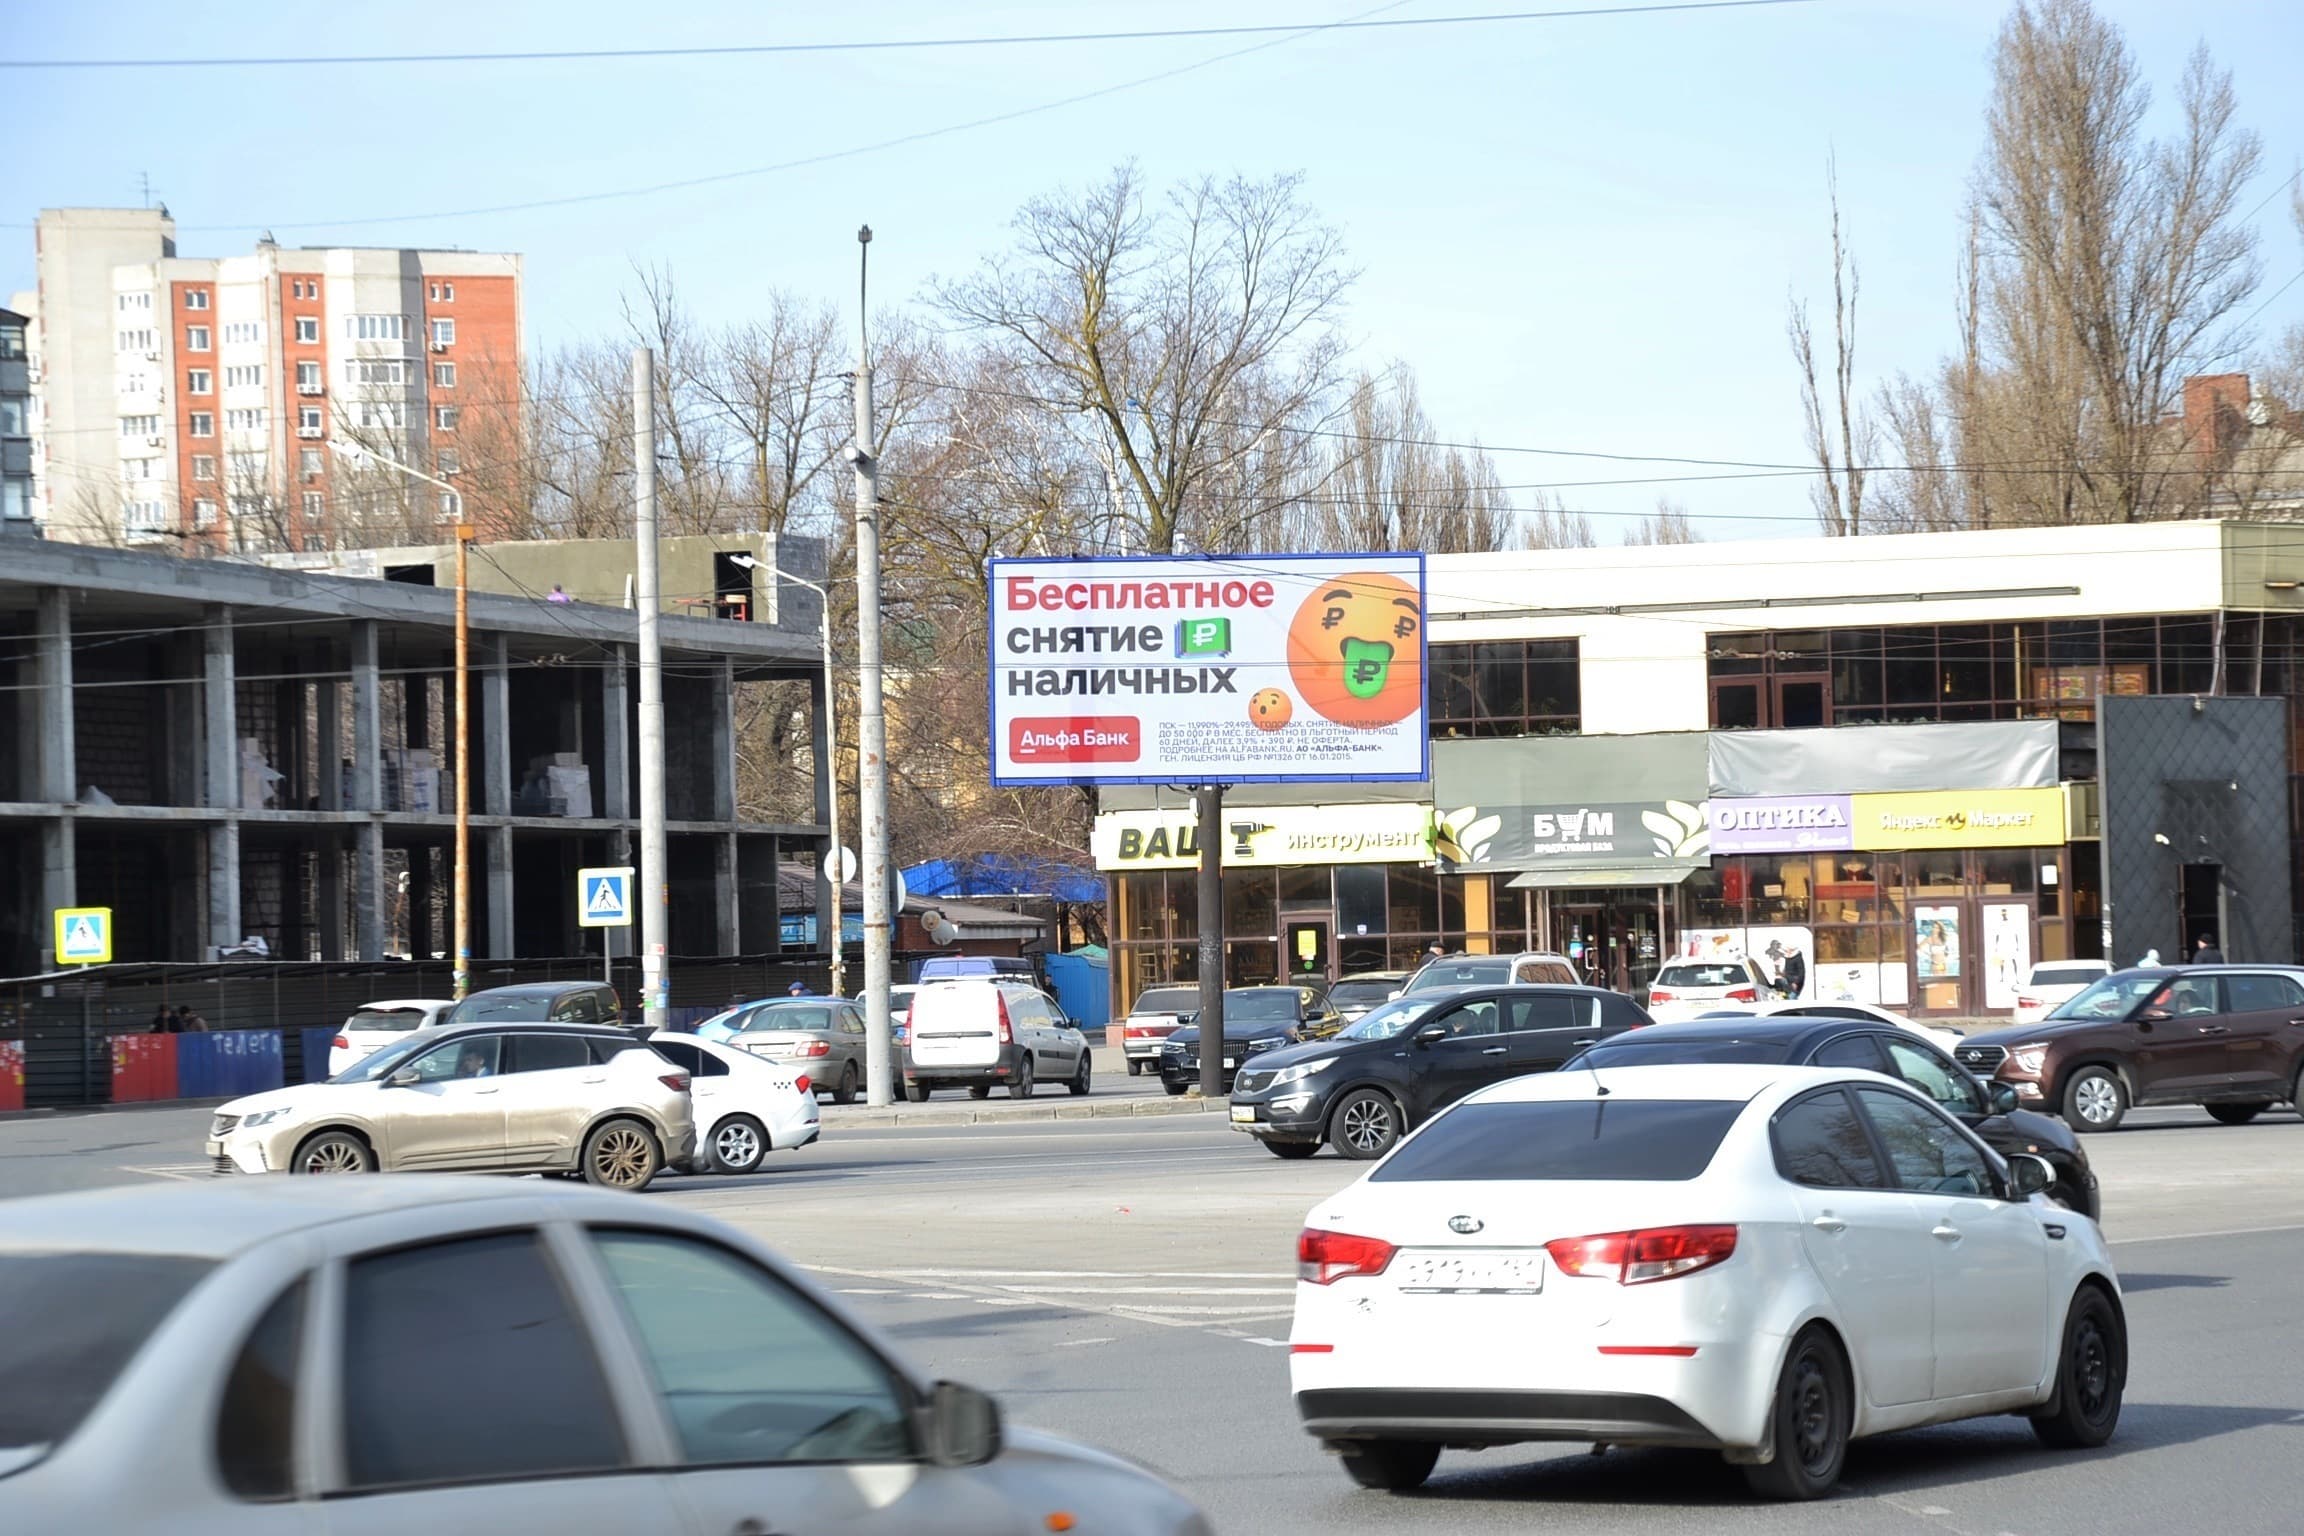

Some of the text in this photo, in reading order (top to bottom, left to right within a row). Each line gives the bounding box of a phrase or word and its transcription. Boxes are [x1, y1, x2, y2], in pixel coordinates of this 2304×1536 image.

[1007, 576, 1275, 611] Бесплатное
[1006, 624, 1164, 654] снятие
[1007, 667, 1238, 696] наличных
[1306, 720, 1340, 728] СНЯТИЕ
[1361, 728, 1398, 736] ПЕРИОД
[1020, 729, 1129, 751] Альфа Банк
[1159, 746, 1213, 754] ПОДРОБНЕЕ
[1181, 754, 1231, 762] ЛИЦЕНЗИЯ
[1715, 804, 1848, 831] ОПТИКА
[1880, 810, 2034, 831] Яндекс Маркет
[1287, 832, 1420, 853] инструмент
